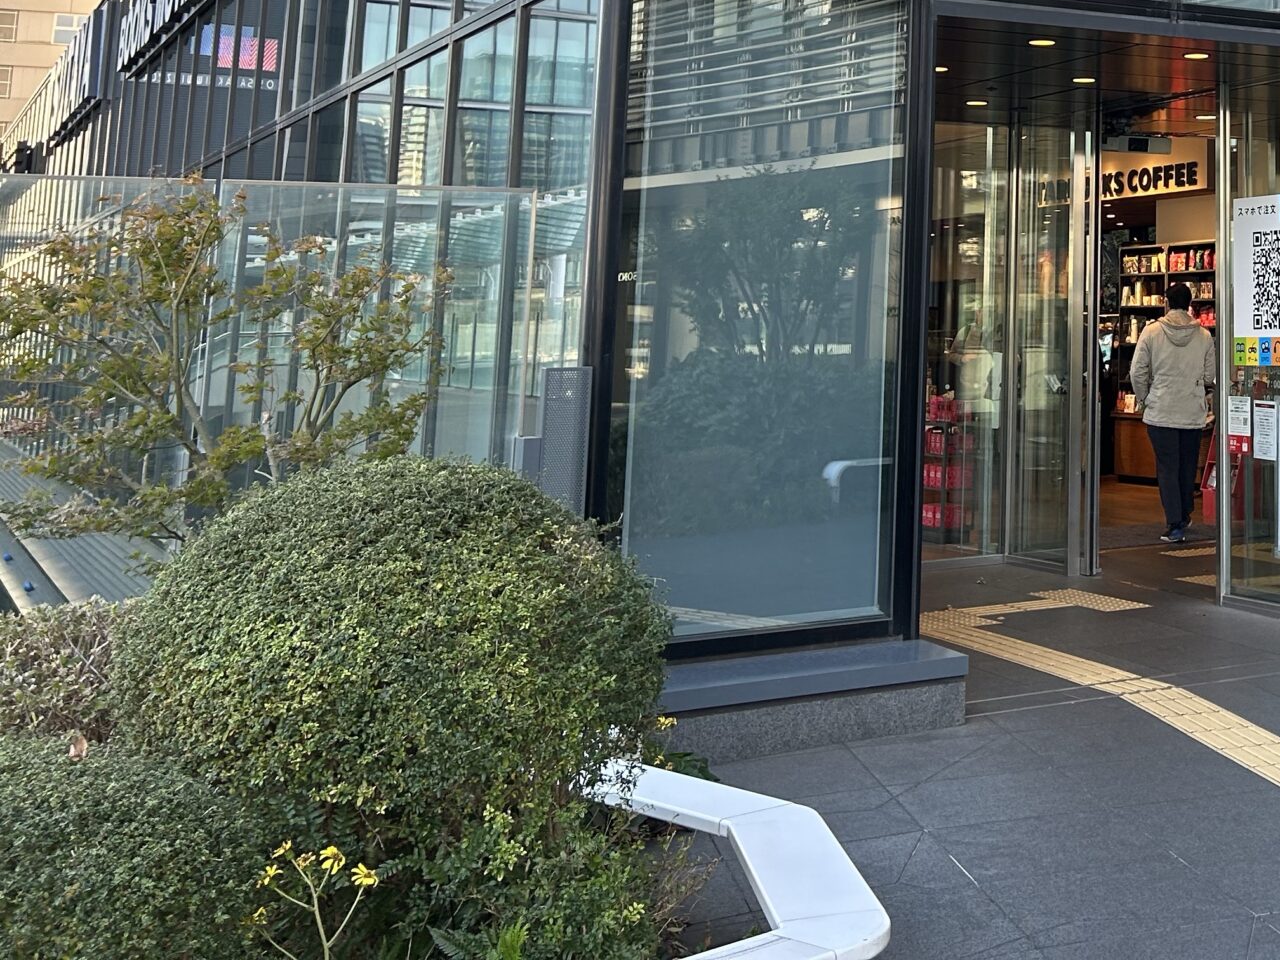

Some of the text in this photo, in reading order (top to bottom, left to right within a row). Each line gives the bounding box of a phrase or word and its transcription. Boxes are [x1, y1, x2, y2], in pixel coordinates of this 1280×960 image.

[1127, 161, 1198, 193] COFFEE
[1238, 204, 1276, 216] スマホで注文
